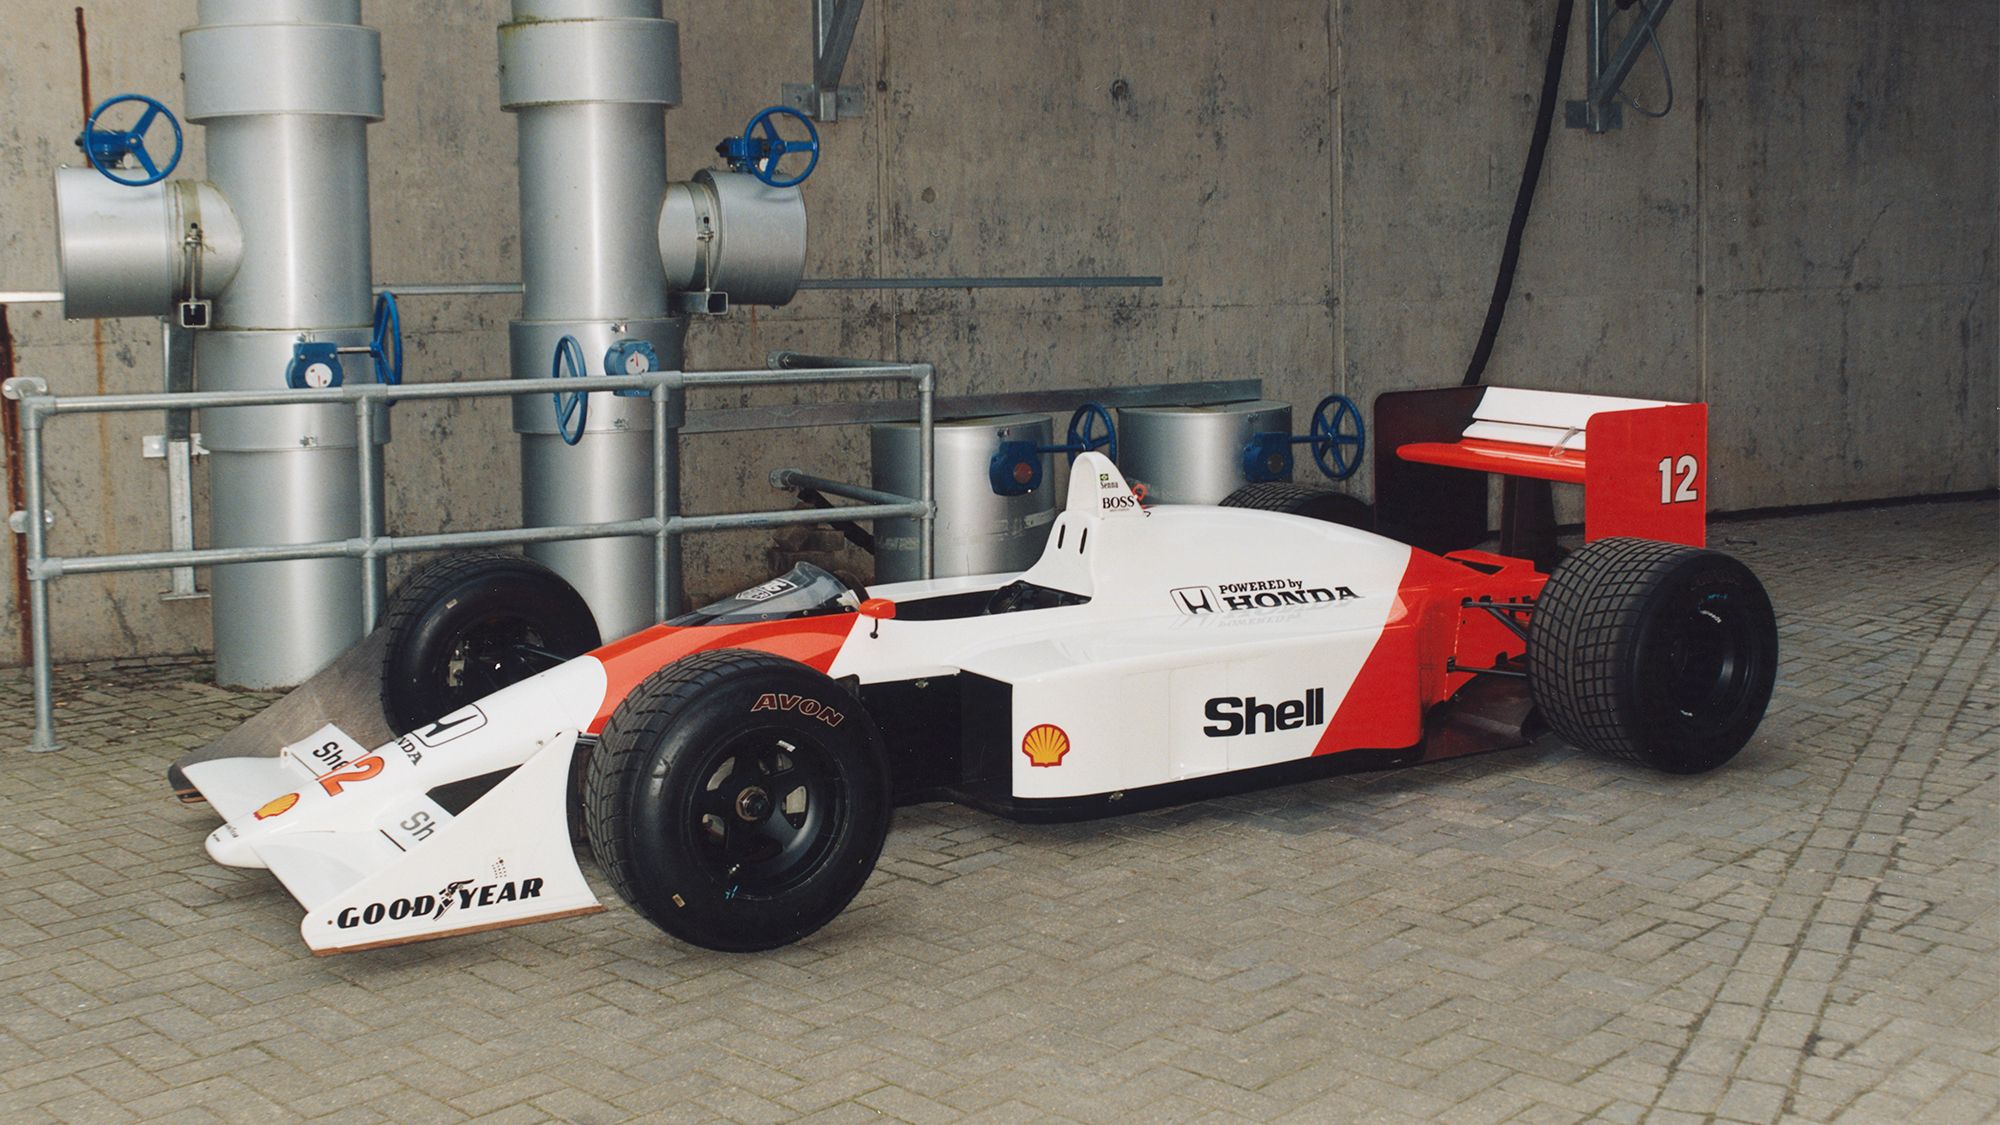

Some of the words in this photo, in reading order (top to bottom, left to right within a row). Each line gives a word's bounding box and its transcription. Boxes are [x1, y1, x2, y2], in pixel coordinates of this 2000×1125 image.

[1658, 454, 1699, 504] 12
[1102, 495, 1135, 509] BOSS
[1219, 580, 1286, 594] POWERED
[1289, 579, 1303, 590] by
[1222, 586, 1363, 611] HONDA
[750, 693, 845, 727] AVON
[1203, 687, 1324, 737] Shell
